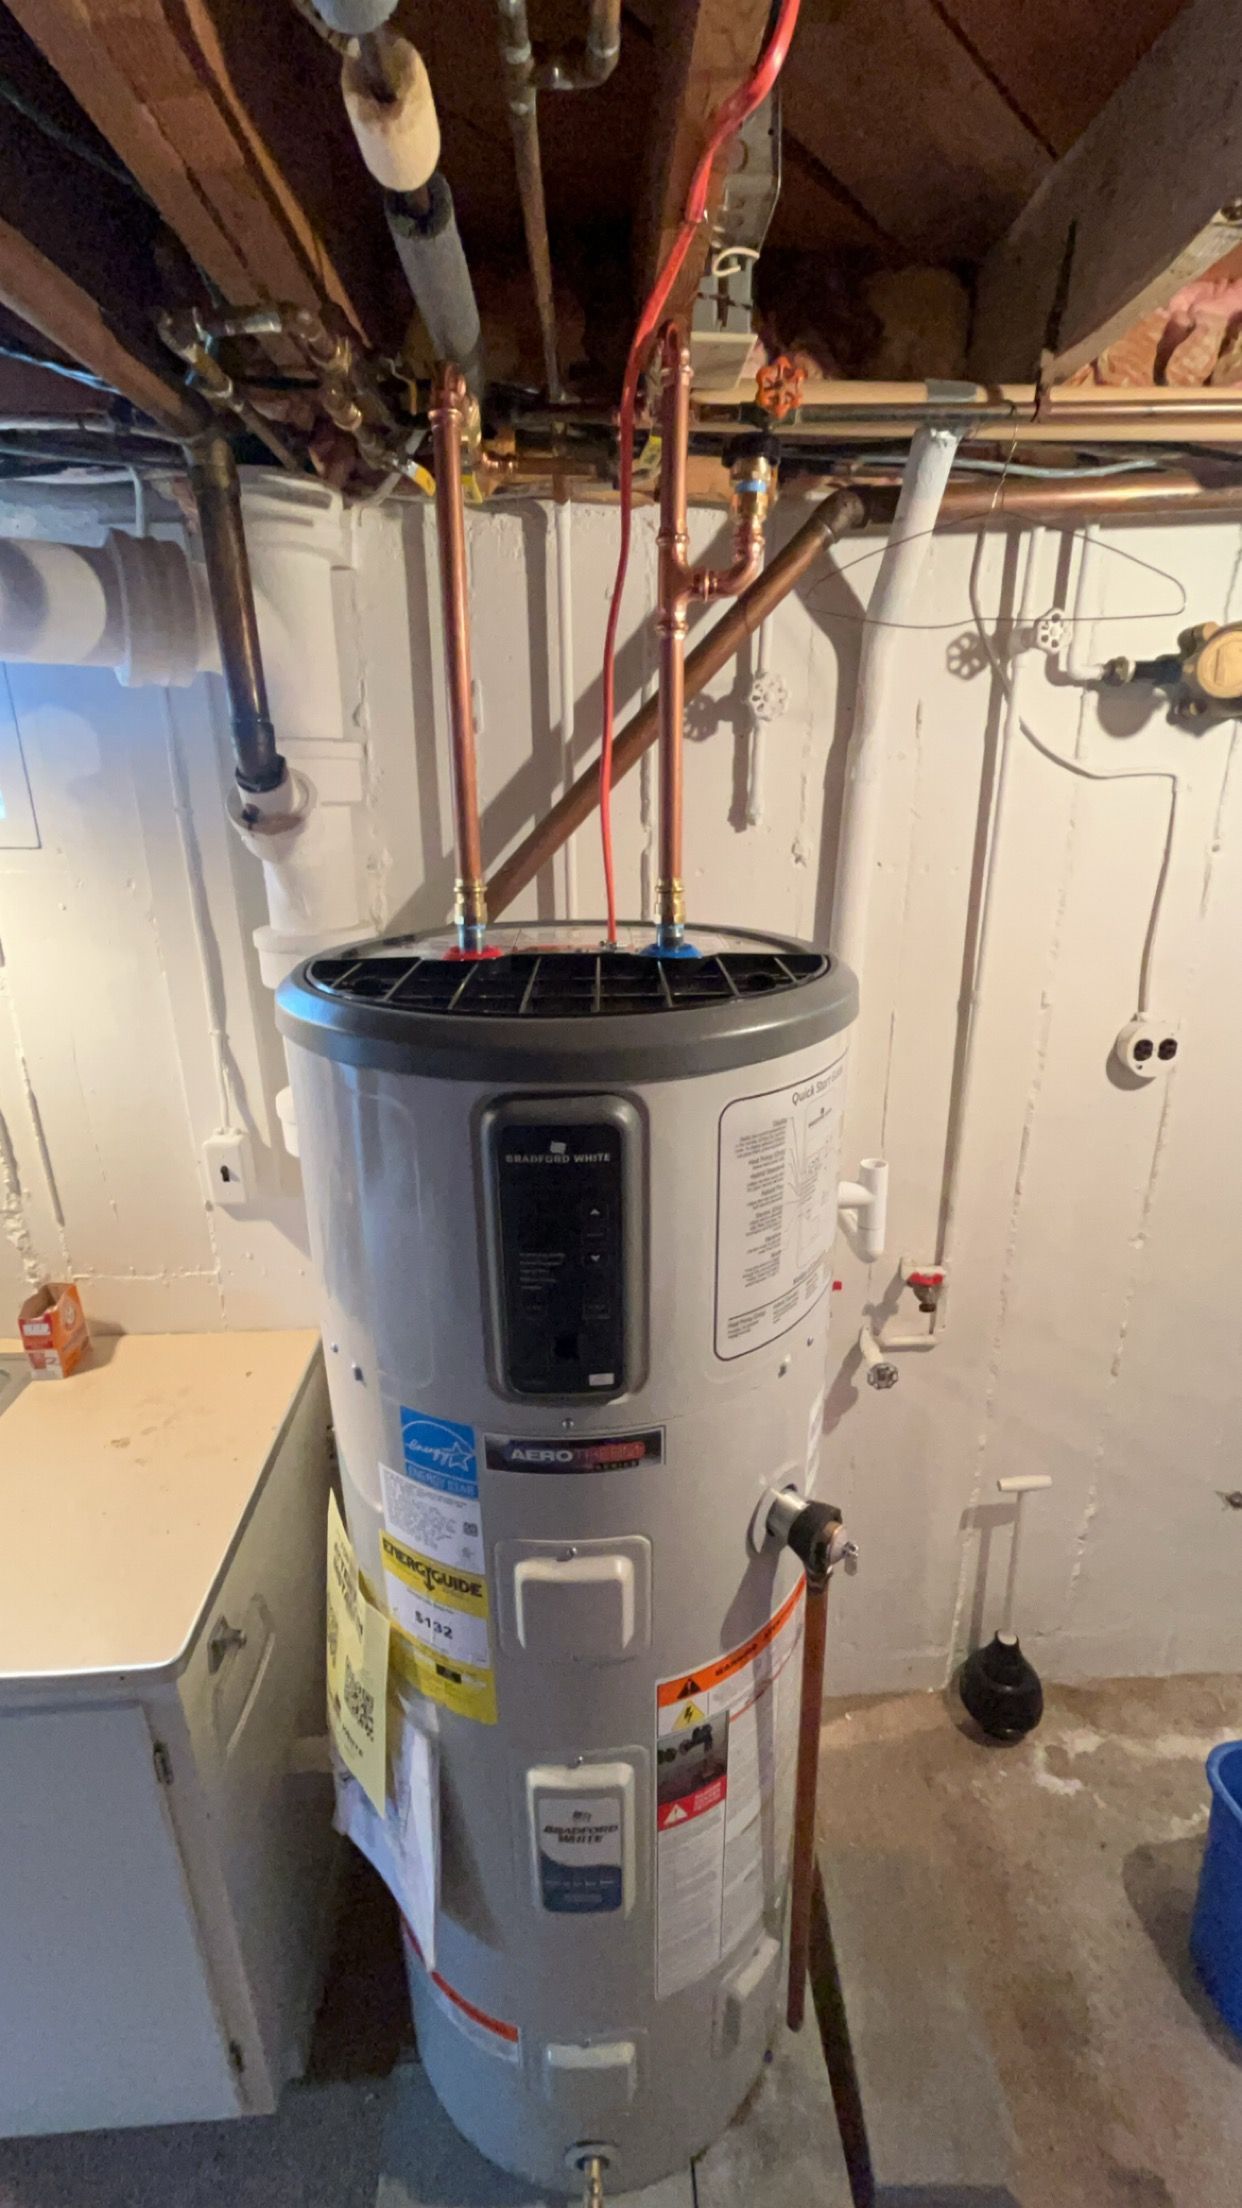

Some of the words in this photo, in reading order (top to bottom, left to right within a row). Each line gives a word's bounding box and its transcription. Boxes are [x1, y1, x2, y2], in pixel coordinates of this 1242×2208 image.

[792, 1084, 814, 1107] Quick
[505, 1153, 570, 1164] BRADFORD
[573, 1152, 611, 1163] WHITE
[543, 1824, 619, 1836] BRADFORD
